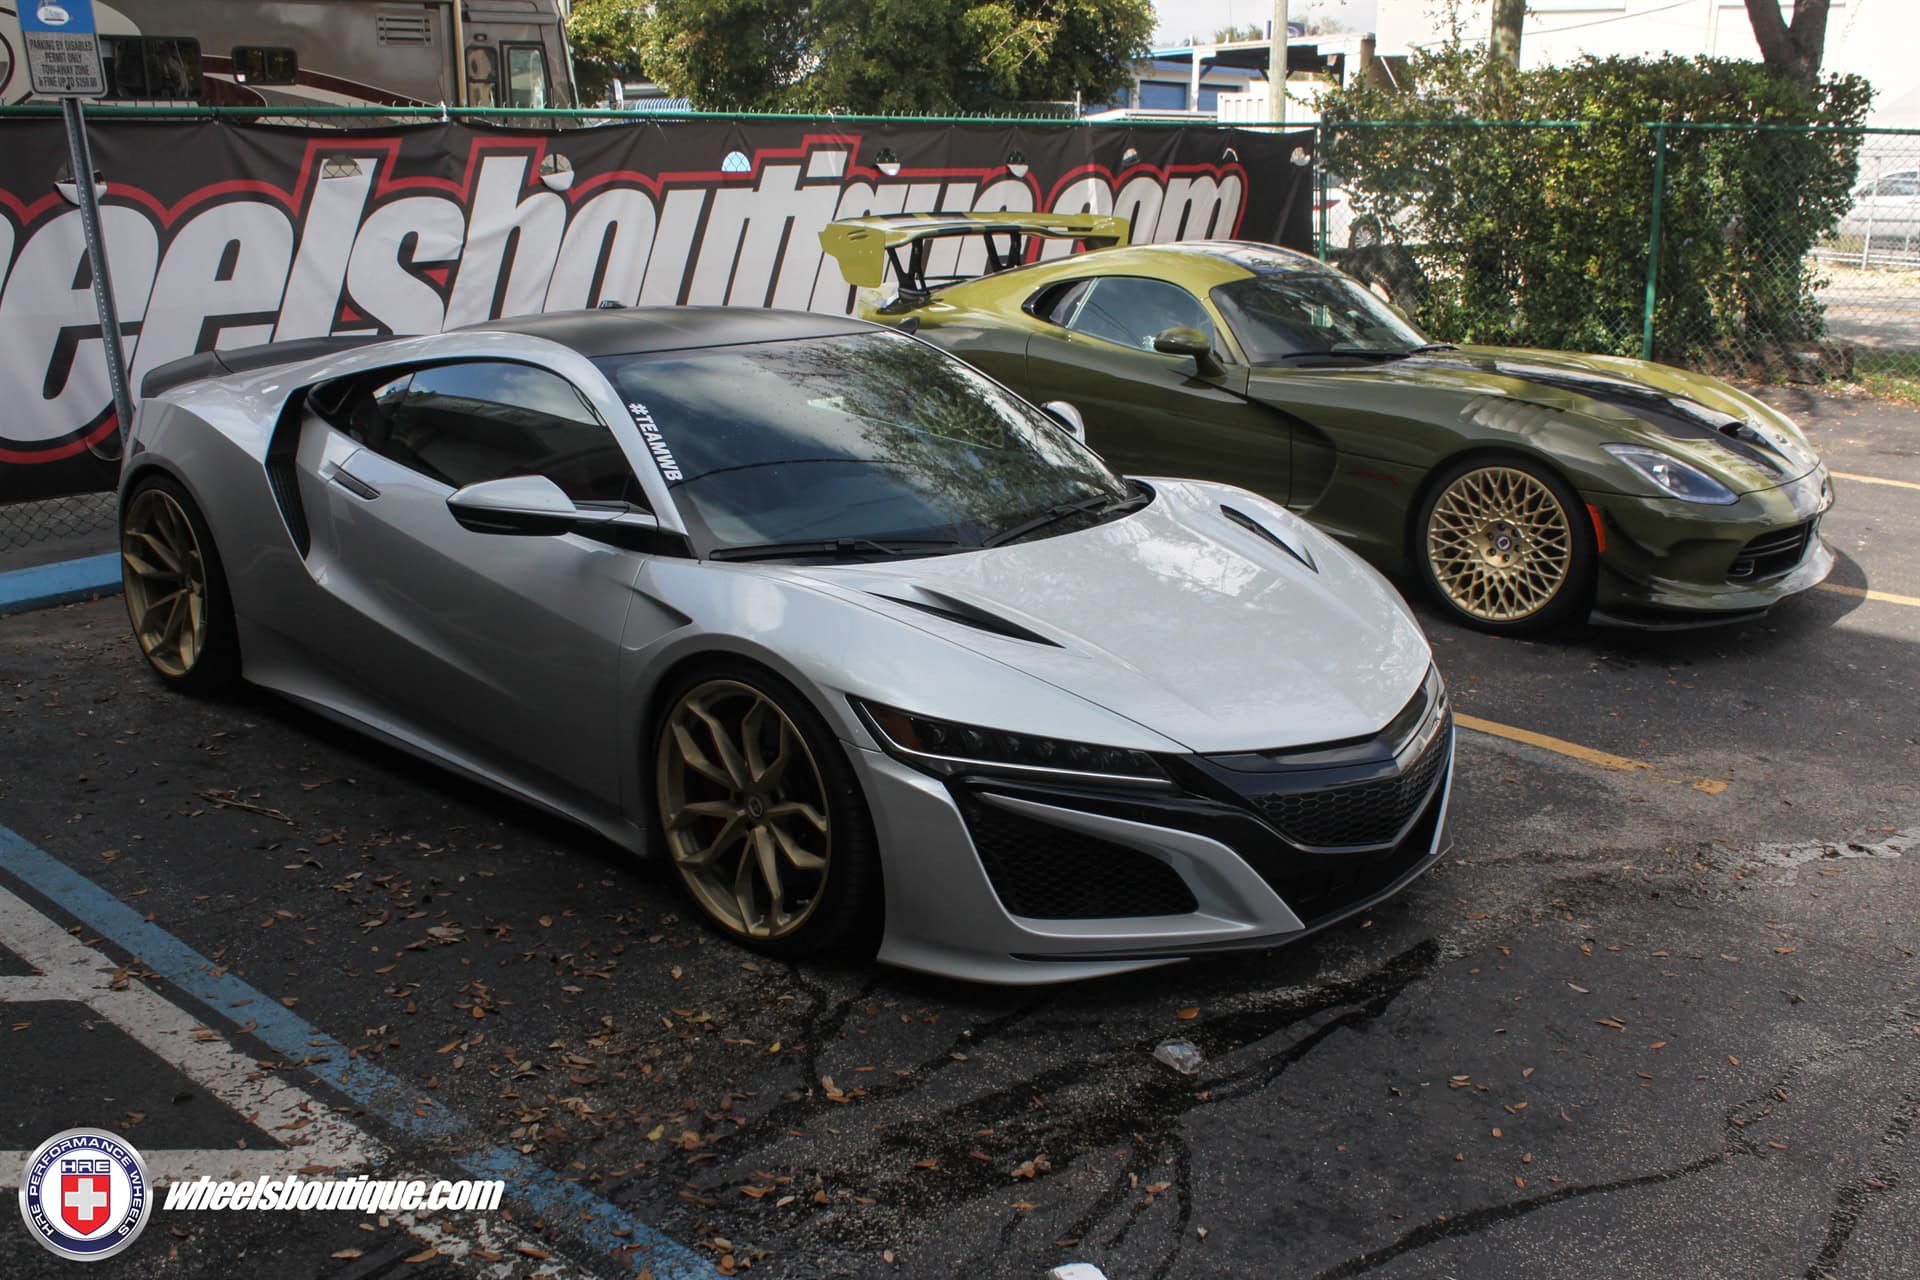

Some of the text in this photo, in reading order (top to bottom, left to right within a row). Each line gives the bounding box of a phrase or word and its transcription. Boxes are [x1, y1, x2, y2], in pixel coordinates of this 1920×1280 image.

[29, 39, 93, 51] PARKING BY DISABLED
[44, 52, 82, 63] PERMIT ONLY
[41, 64, 90, 76] TOW-AWAY ZONE
[43, 76, 58, 87] FINE
[58, 76, 66, 87] UP
[628, 402, 684, 481] #TEAMWB
